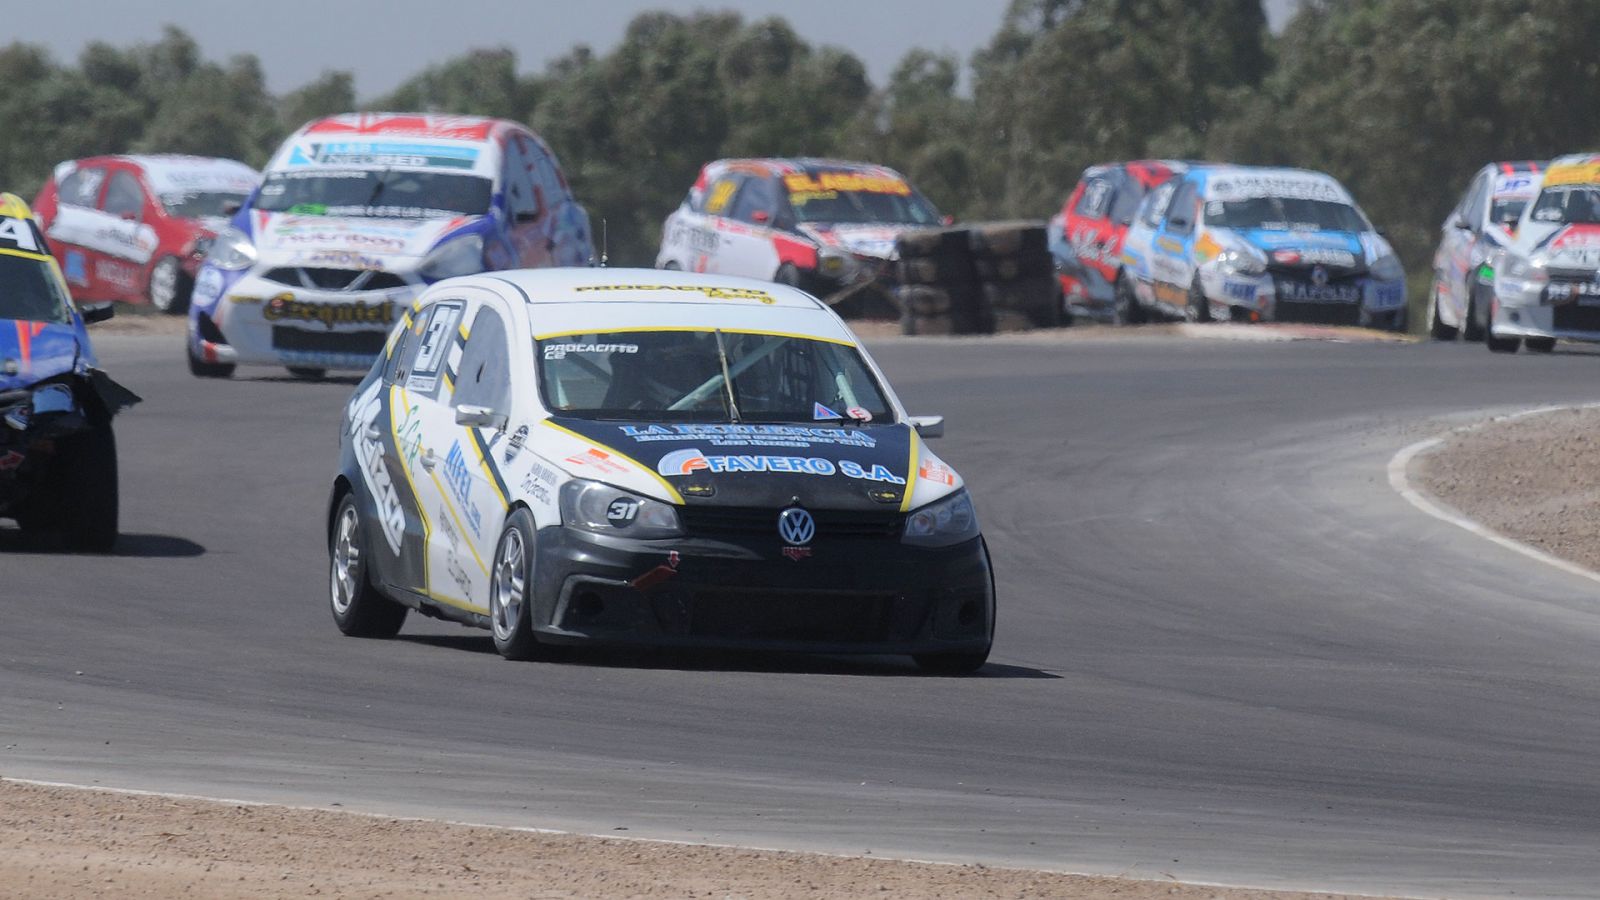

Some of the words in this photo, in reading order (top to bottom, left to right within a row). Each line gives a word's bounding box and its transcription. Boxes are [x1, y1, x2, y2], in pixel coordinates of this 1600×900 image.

[576, 285, 767, 295] PROCACITTO
[544, 343, 639, 354] PROCACITTO
[618, 425, 673, 437] LA
[705, 456, 836, 476] FAVERO
[838, 462, 905, 484] S.A.
[607, 502, 638, 520] 31
